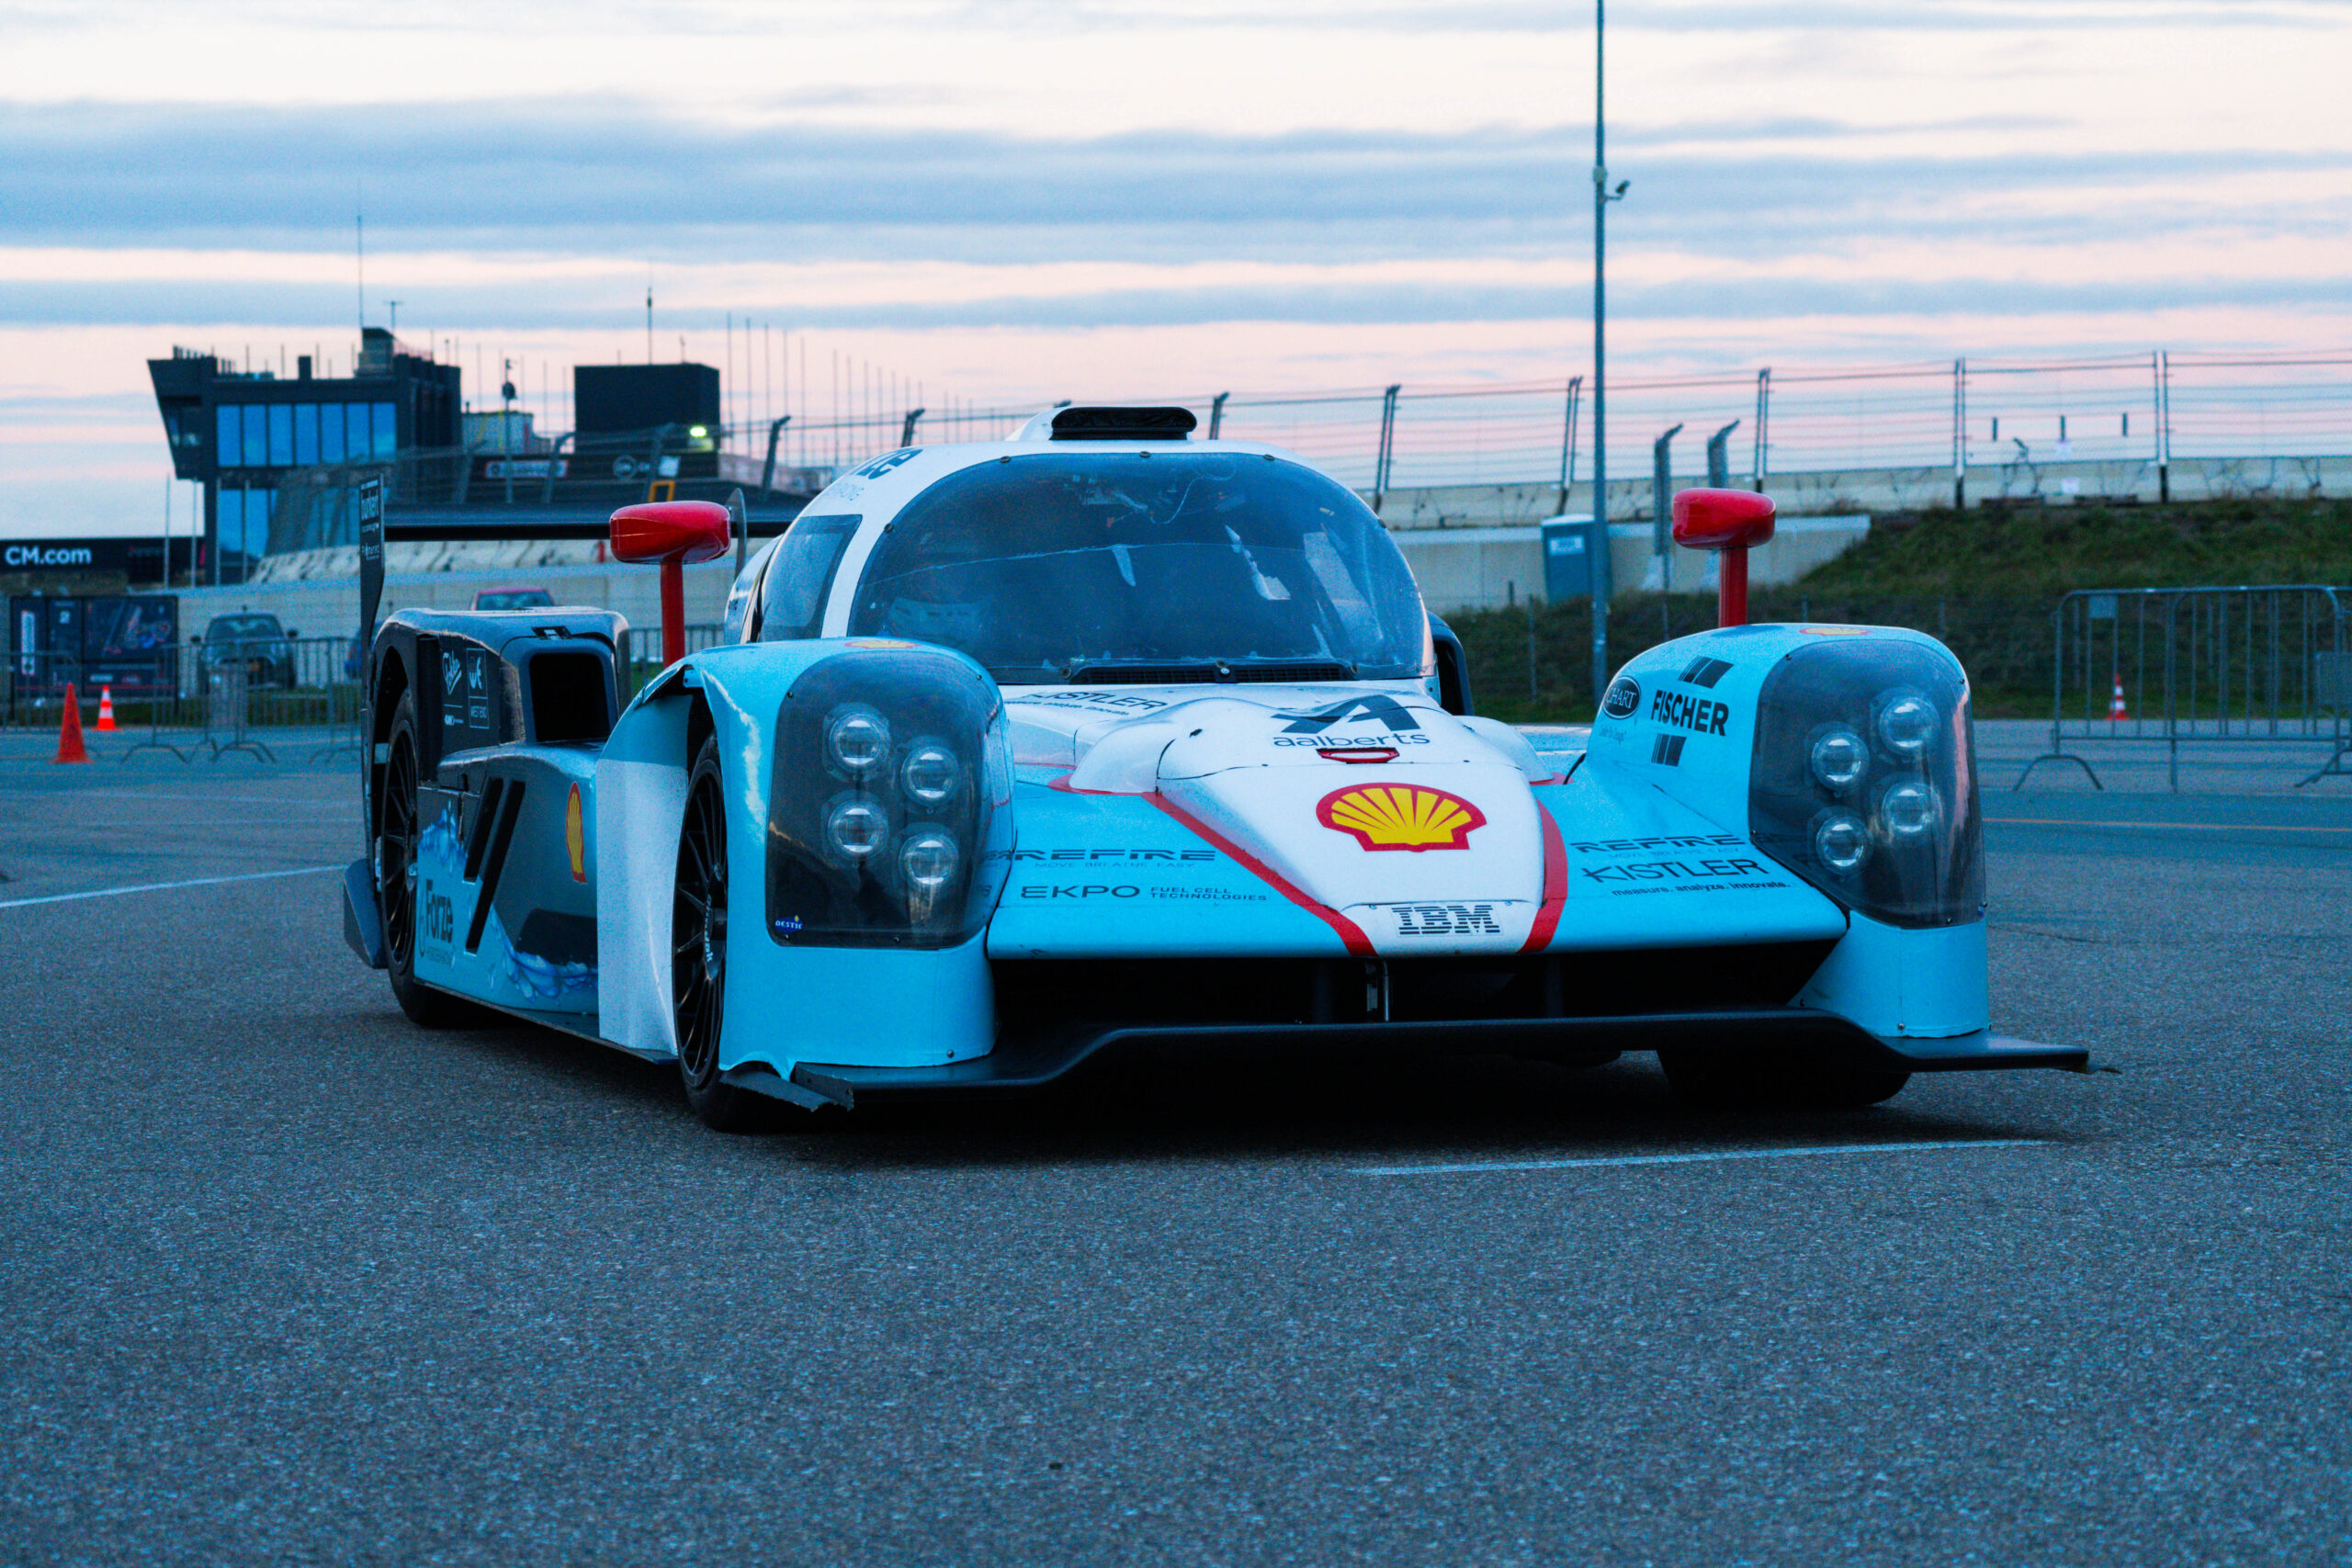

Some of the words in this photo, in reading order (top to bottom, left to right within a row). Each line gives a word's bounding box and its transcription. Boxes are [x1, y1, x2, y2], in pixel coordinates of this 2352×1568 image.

[5, 545, 92, 565] CM.com
[1606, 687, 1637, 709] CHART
[1650, 689, 1729, 737] FISCHER
[1273, 734, 1430, 747] aalberts
[1570, 834, 1746, 853] REFIRE
[1014, 849, 1216, 862] REFIRE
[1580, 859, 1770, 883] KISTLER
[1021, 885, 1141, 898] EKPO
[1149, 893, 1267, 901] TECHNOLOGIES
[1611, 886, 1673, 897] measure.
[1675, 883, 1729, 893] analyze.
[1731, 880, 1791, 890] innovate.
[425, 879, 453, 943] Forze
[1390, 905, 1500, 935] IBM
